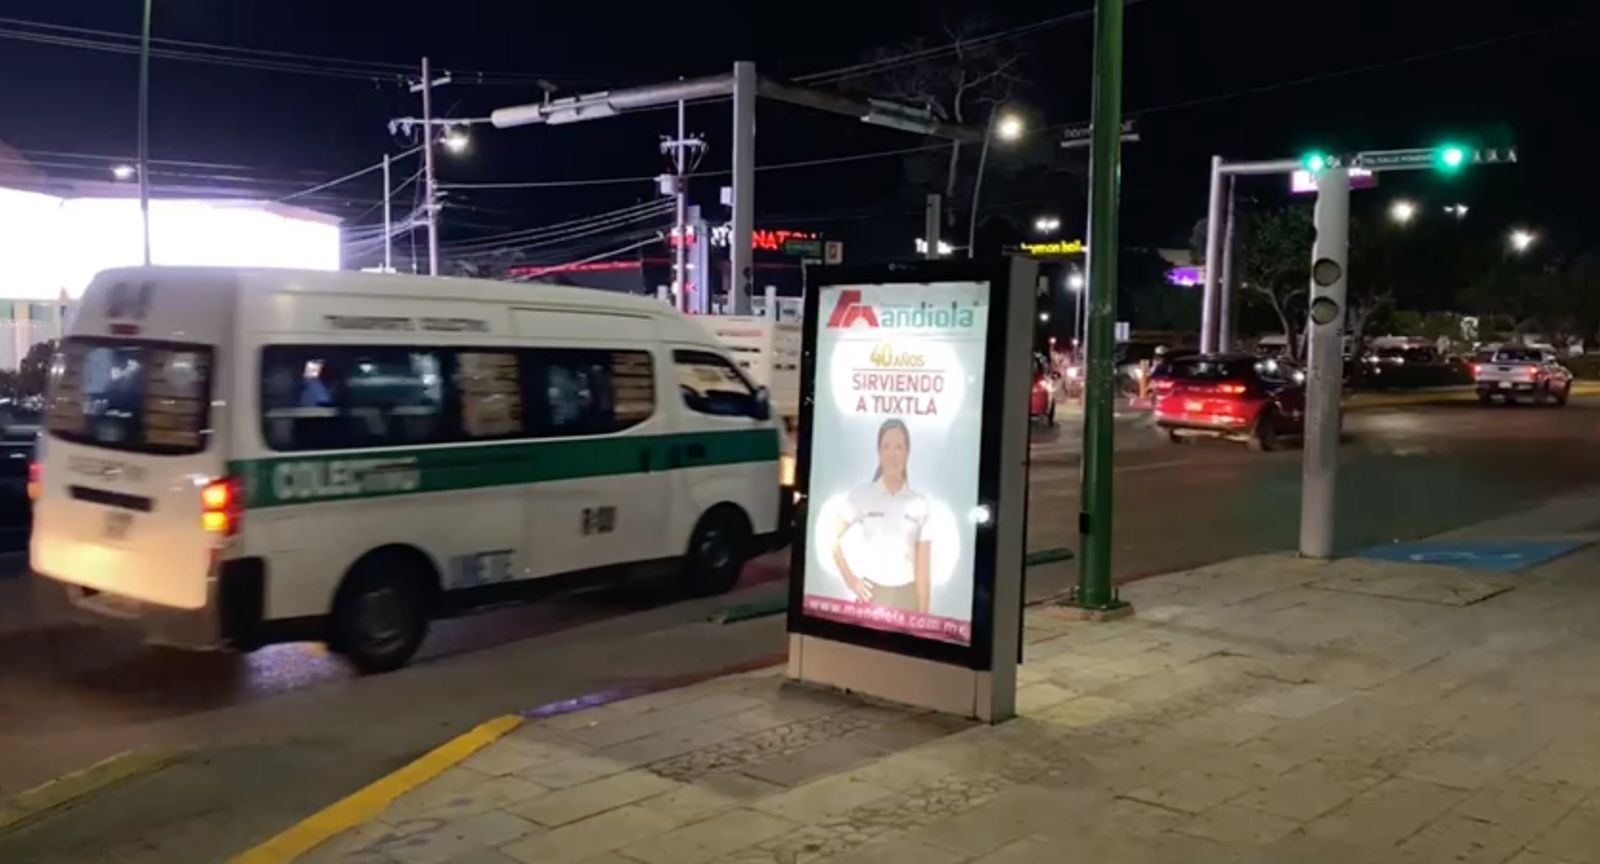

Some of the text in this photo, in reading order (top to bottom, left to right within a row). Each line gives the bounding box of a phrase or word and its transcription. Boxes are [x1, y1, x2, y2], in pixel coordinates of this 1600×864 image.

[870, 343, 925, 368] 40 AÑOS
[851, 373, 945, 393] SIRVIENDO
[856, 395, 938, 416] A TUXTLA
